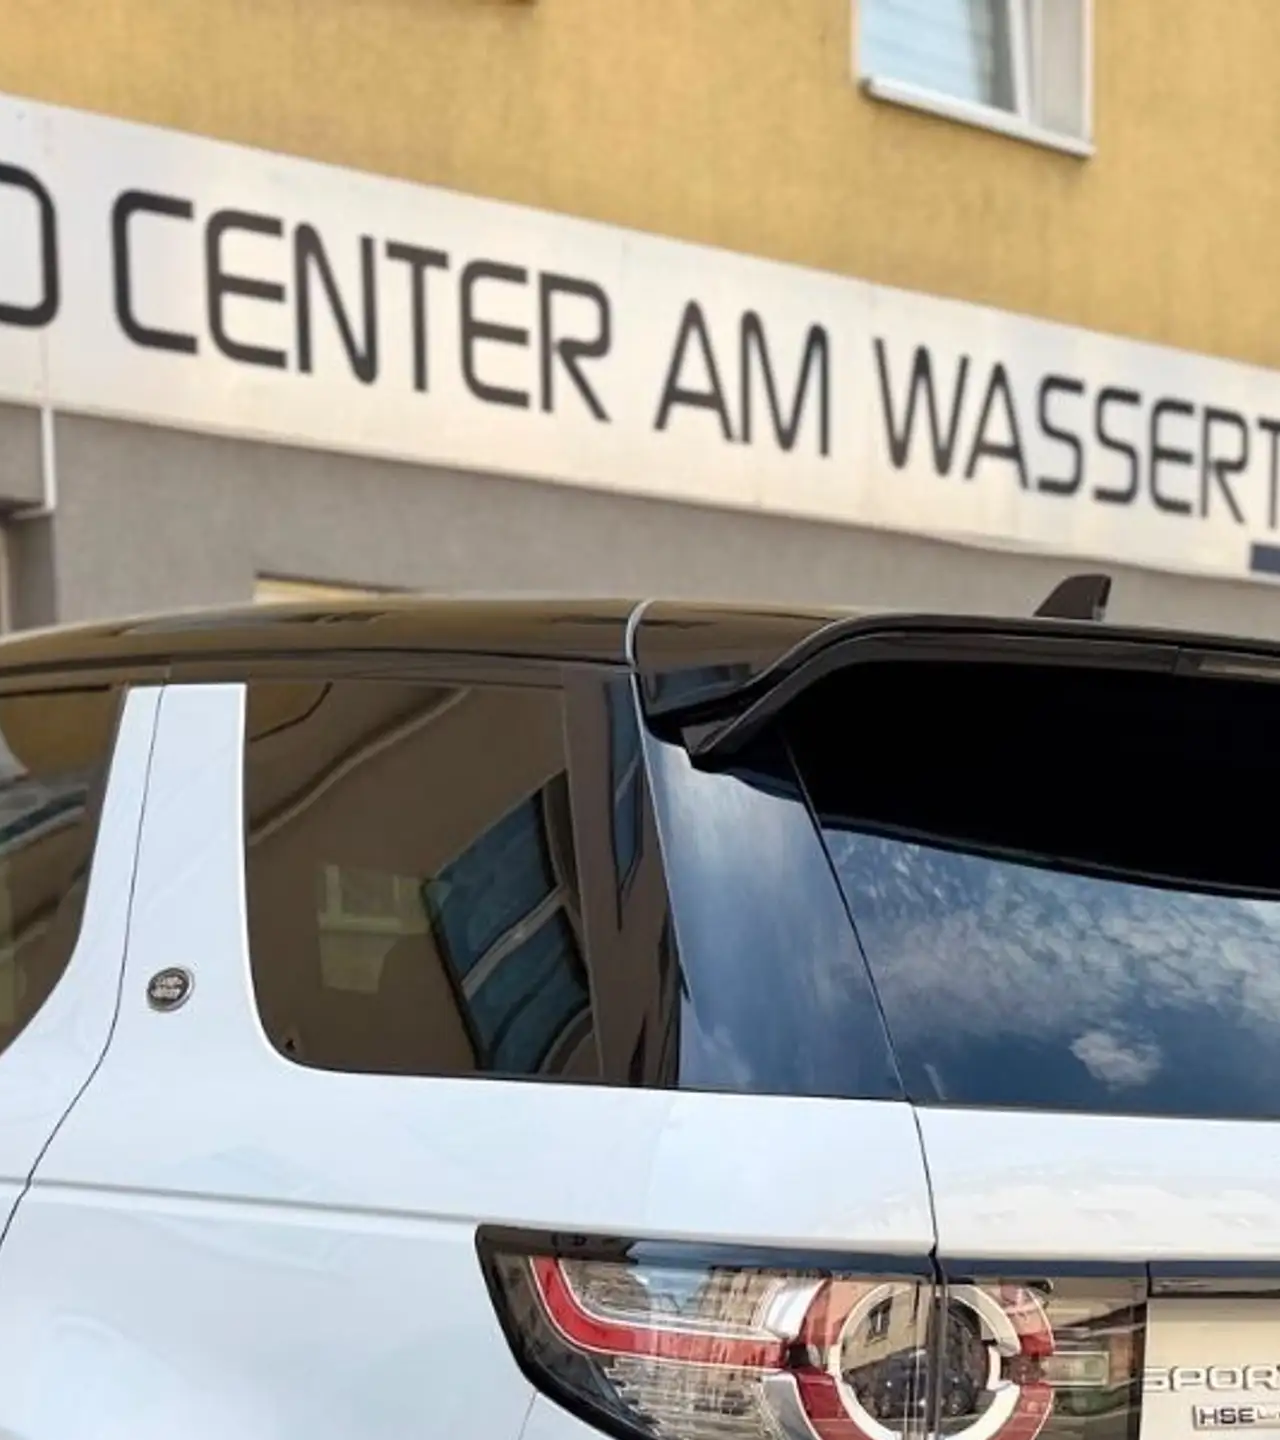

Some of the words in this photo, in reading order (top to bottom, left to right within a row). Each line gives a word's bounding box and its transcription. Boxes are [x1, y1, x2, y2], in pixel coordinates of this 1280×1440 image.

[110, 188, 613, 424] CENTER
[654, 299, 831, 458] AM
[1199, 1407, 1256, 1425] HSE
